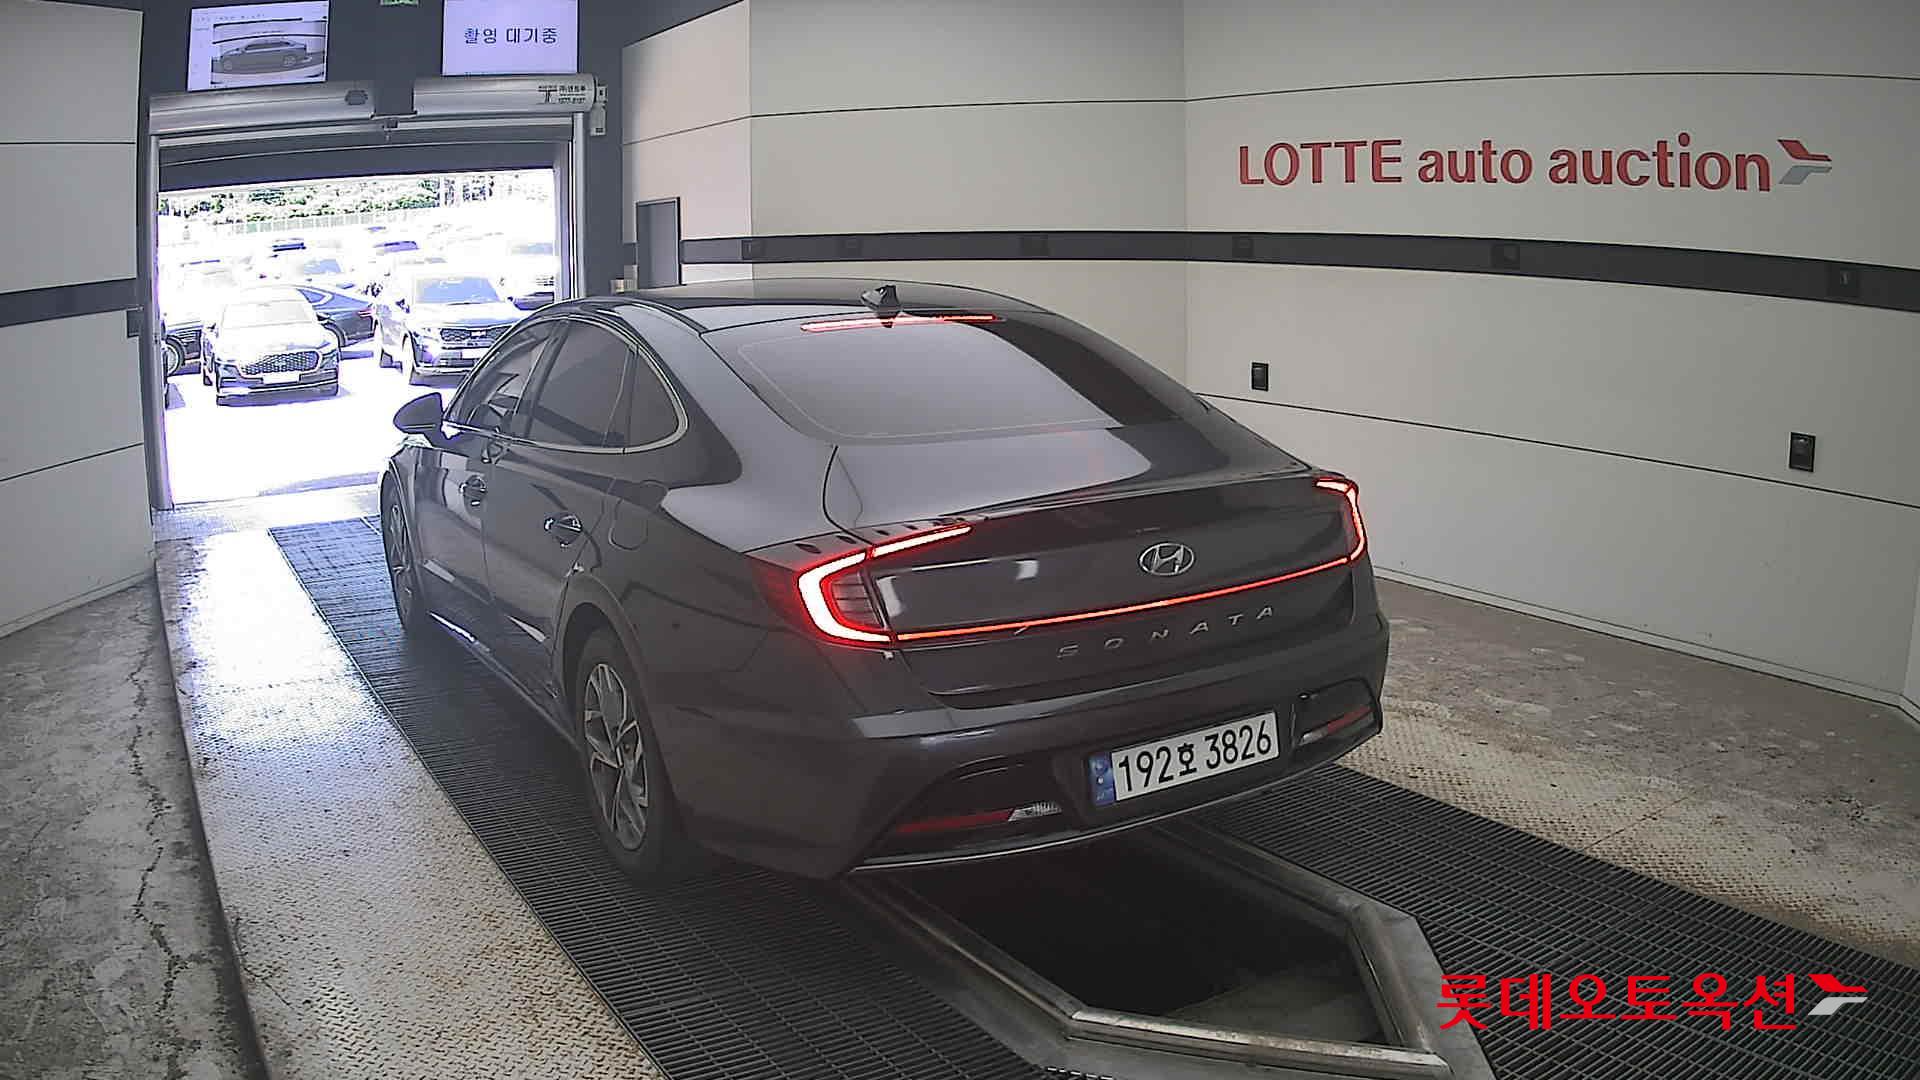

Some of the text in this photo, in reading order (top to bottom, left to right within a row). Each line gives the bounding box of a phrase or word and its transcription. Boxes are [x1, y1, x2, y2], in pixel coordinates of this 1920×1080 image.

[506, 27, 558, 44] 대기중
[1239, 132, 1770, 192] LOTTE auto auction
[1056, 606, 1273, 660] SONATA
[1118, 719, 1272, 792] 192호 3826
